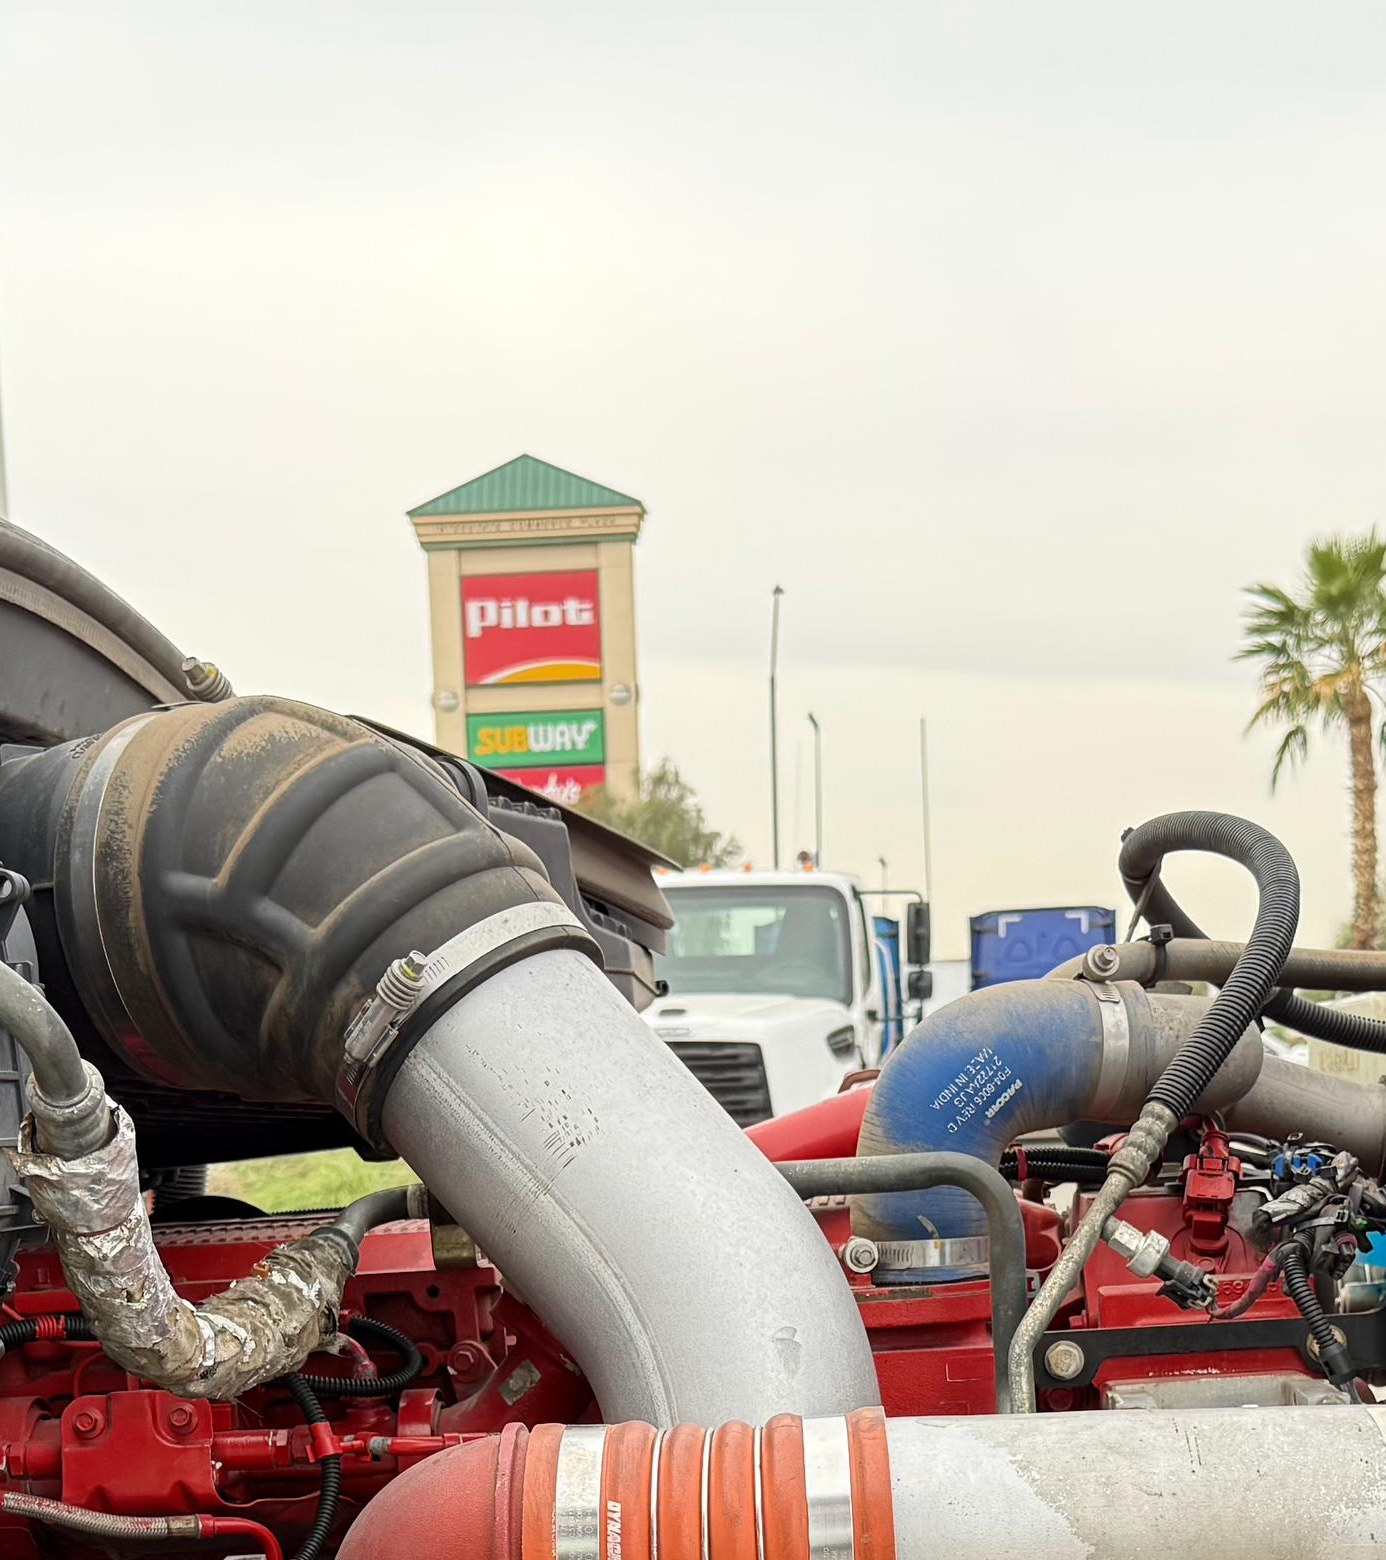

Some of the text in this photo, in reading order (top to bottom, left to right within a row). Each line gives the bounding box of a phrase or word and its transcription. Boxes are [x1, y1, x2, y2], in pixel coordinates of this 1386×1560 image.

[465, 597, 595, 638] Pilot
[475, 720, 598, 755] SUBWAY
[930, 1085, 959, 1111] INDIA
[957, 1103, 976, 1126] REV
[985, 1079, 1023, 1119] PACCAR
